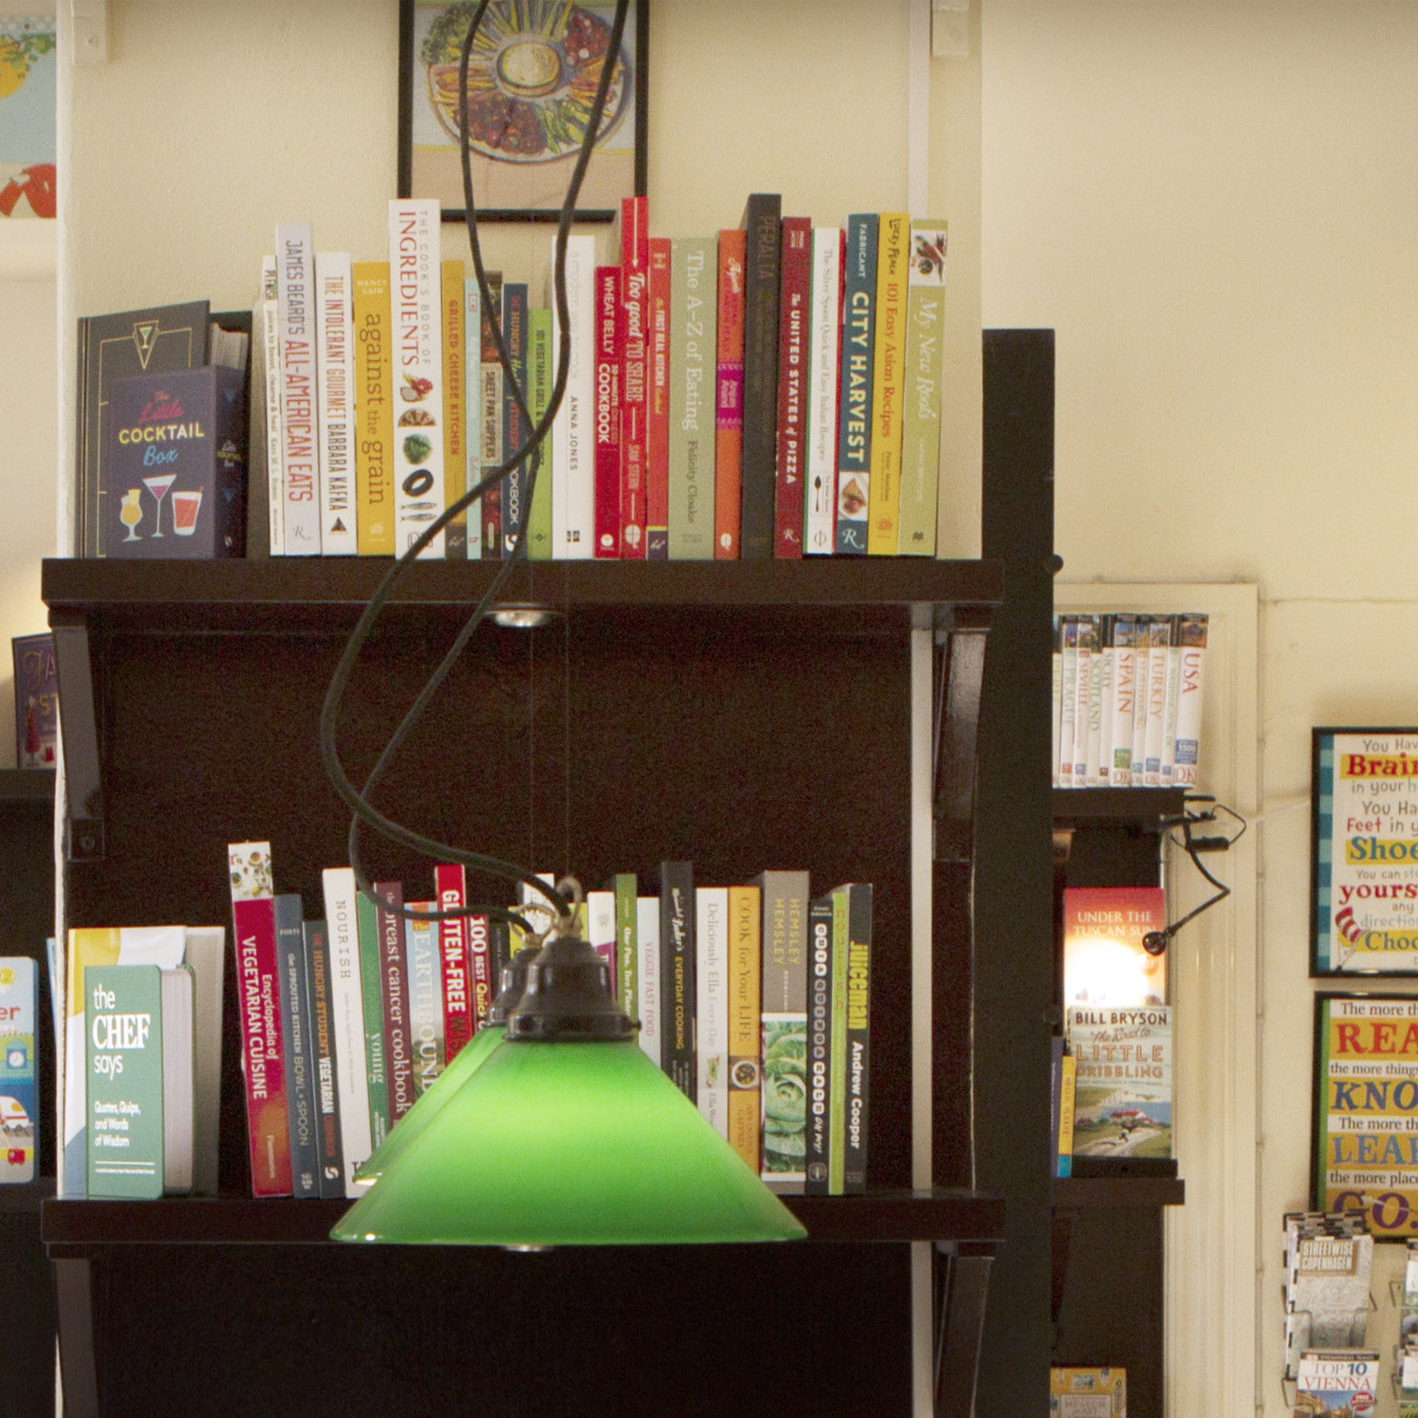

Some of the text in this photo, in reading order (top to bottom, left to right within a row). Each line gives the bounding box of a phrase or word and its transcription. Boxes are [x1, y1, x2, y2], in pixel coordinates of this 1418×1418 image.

[858, 223, 868, 278] FABRICANT
[399, 212, 419, 366] INGREDIENTS
[598, 363, 611, 444] COOKBOOK
[847, 291, 870, 463] CITY HARVEST
[119, 423, 205, 444] COCKTAIL
[143, 446, 178, 466] Box
[569, 396, 579, 471] ANNA JONES
[1118, 653, 1132, 714] SPAIN
[1183, 652, 1200, 694] USA
[335, 900, 351, 979] NOURISH
[706, 903, 719, 994] Deliciously Ella
[773, 899, 785, 964] HEMSLEY
[788, 899, 800, 964] HEMSLEY
[93, 984, 116, 1009] the
[475, 954, 487, 981] BEST
[92, 1013, 150, 1049] CHEF
[242, 935, 268, 1100] VEGETARIAN CUISINE
[94, 1053, 123, 1080] says
[1075, 1045, 1164, 1062] LITTLE
[1305, 1377, 1371, 1390] VIENNA
